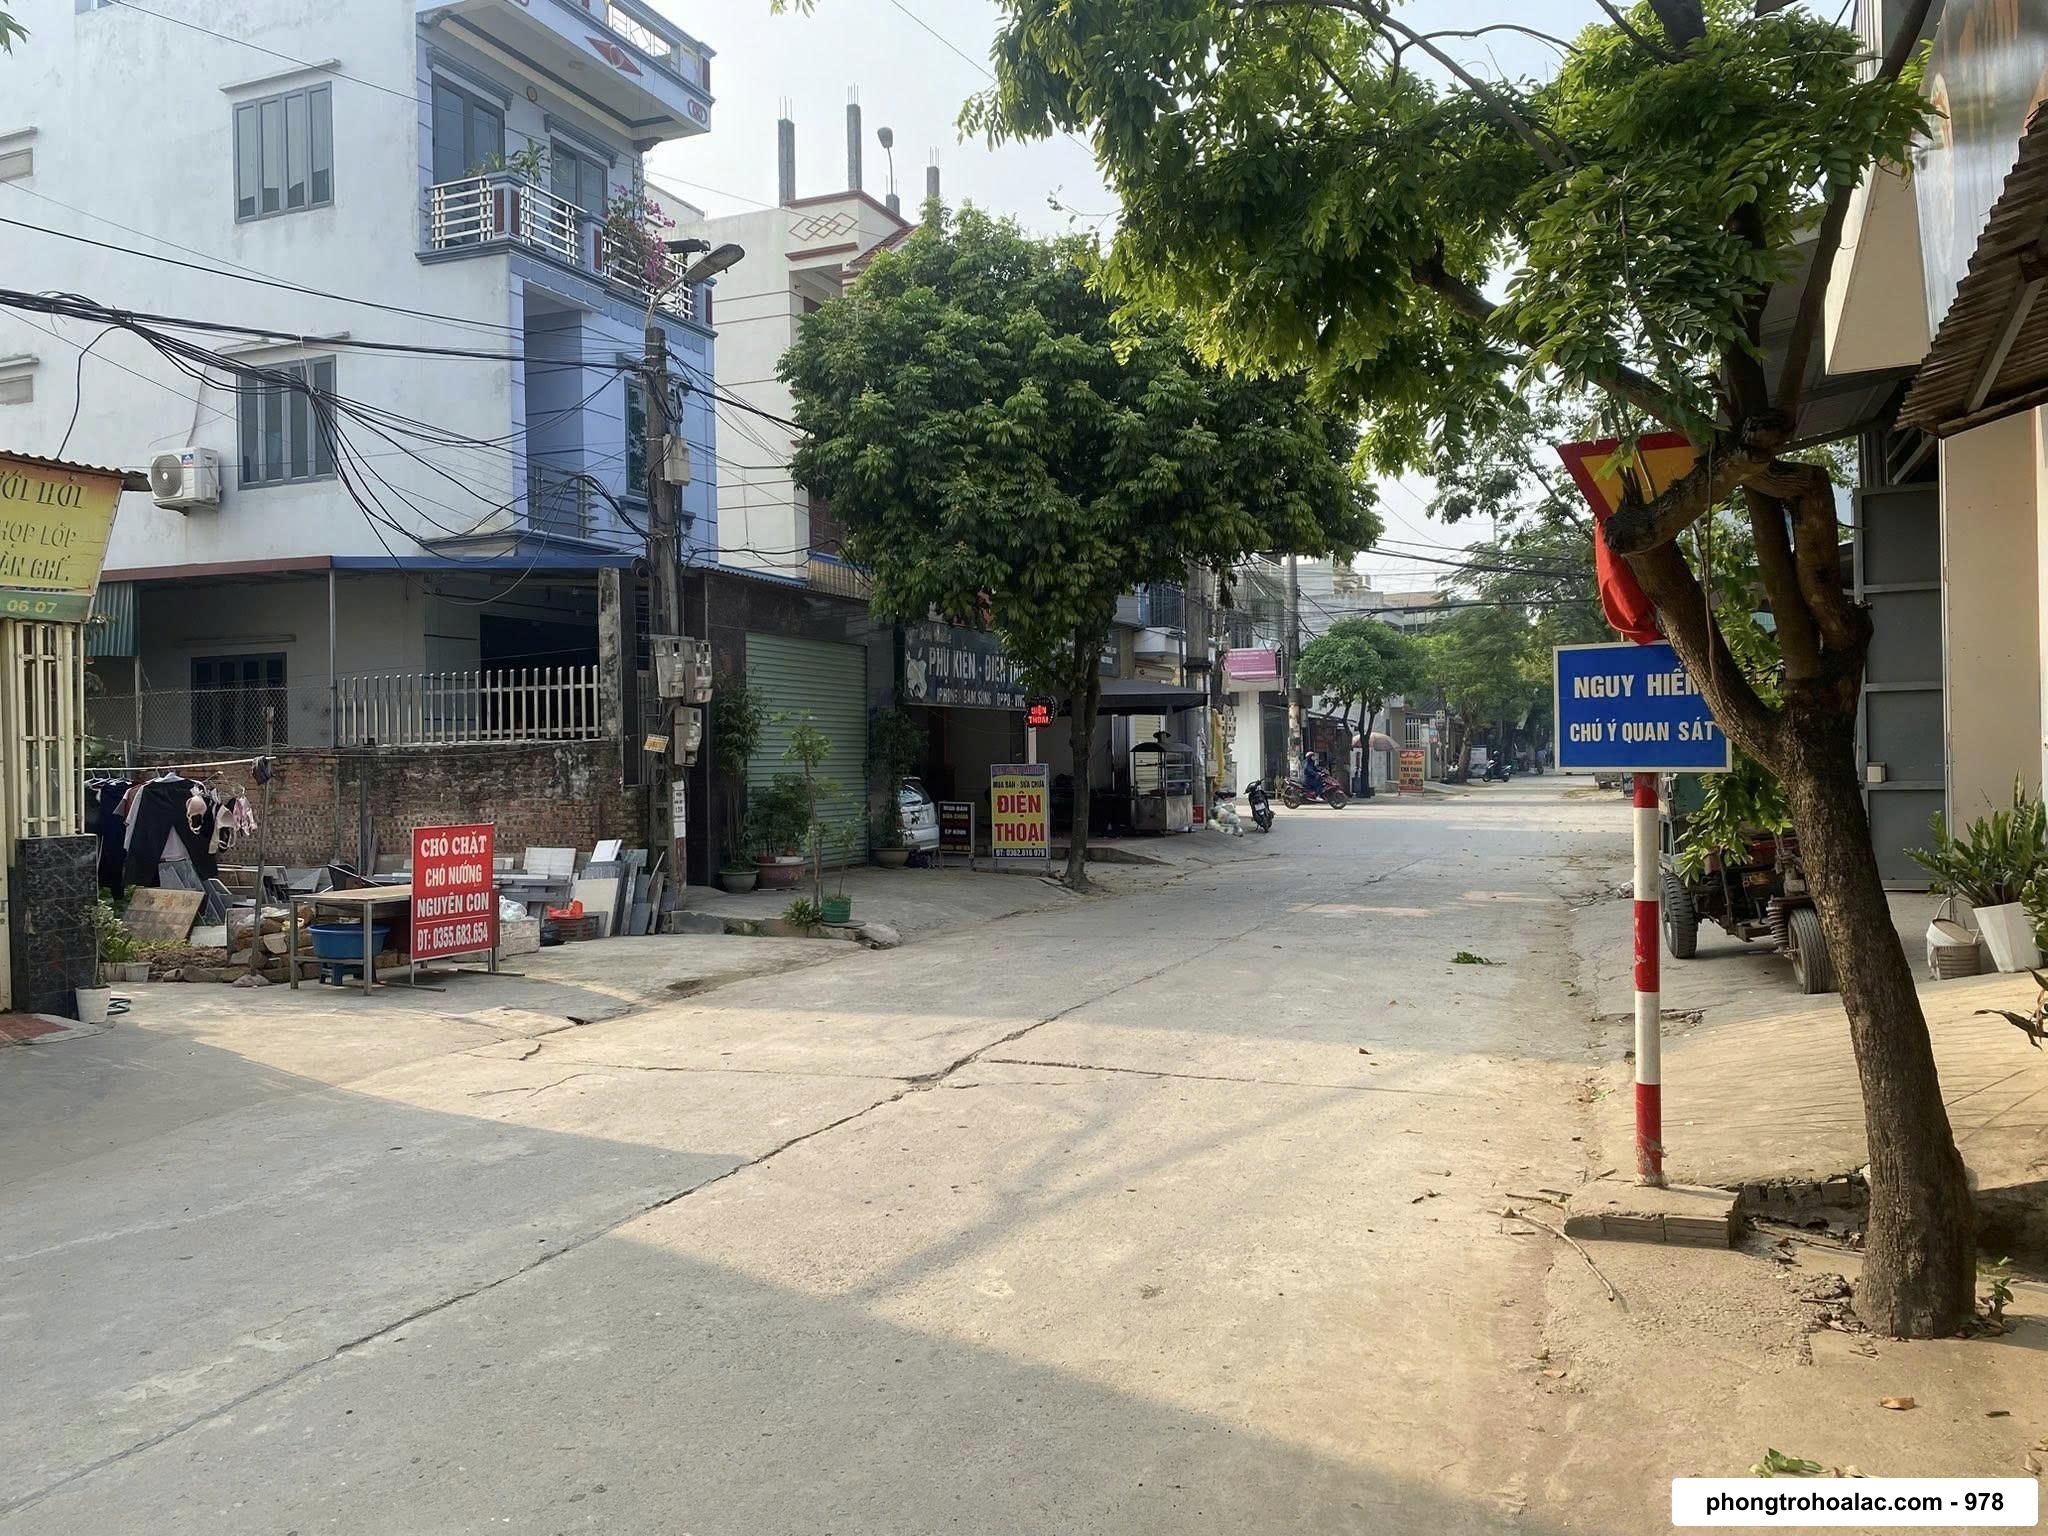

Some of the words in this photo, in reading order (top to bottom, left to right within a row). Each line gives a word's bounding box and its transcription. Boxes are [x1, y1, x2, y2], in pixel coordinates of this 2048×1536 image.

[0, 470, 30, 502] ỚI
[7, 600, 29, 613] 06
[35, 601, 57, 614] 07
[928, 646, 950, 684] PHỤ
[953, 645, 976, 685] KIỆN
[1574, 674, 1635, 699] NGUY
[1570, 718, 1603, 742] CHÚ
[1606, 718, 1617, 742] Ý
[1621, 721, 1670, 744] QUAN
[1678, 716, 1715, 742] SÁT
[997, 790, 1042, 817] ĐIỆN
[421, 832, 449, 858] CHÓ
[452, 829, 488, 858] CHẶT
[994, 822, 1046, 847] THOẠI
[425, 863, 446, 888] CHÓ
[448, 860, 482, 886] NƯỚNG
[417, 892, 464, 918] NGUYÊN
[466, 892, 489, 913] CON
